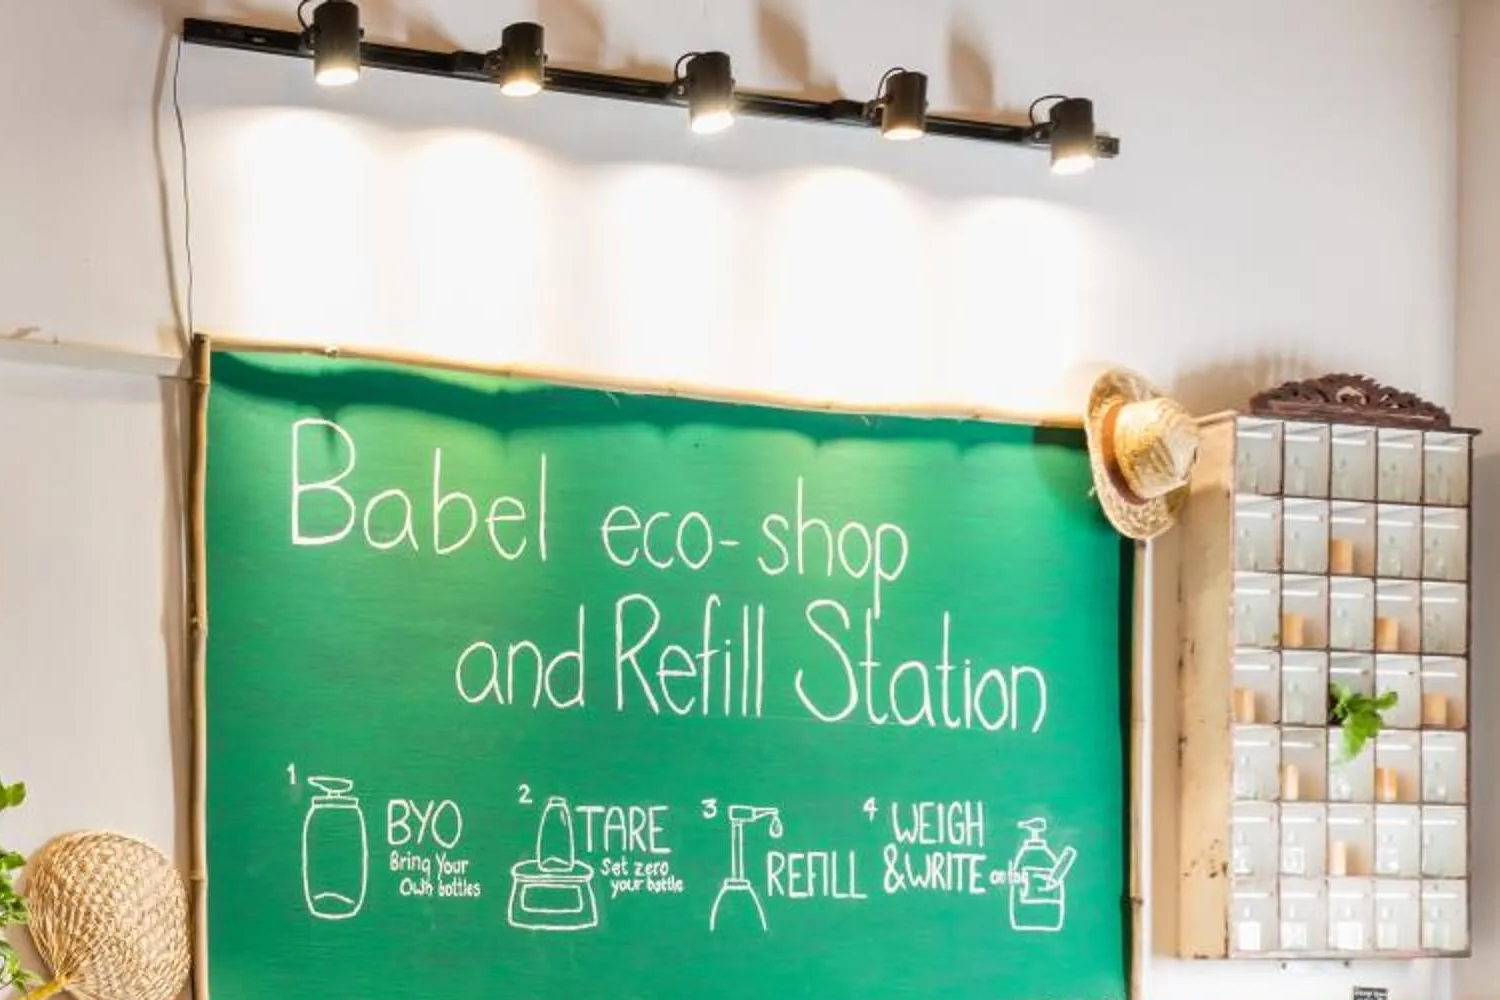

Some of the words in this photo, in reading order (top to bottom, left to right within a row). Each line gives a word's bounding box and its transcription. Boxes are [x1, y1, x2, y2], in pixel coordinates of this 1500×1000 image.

[292, 418, 547, 563] Babel
[455, 604, 584, 708] and
[615, 593, 764, 717] Refill
[795, 599, 1047, 733] Station
[286, 762, 297, 785] 1
[518, 783, 533, 804] 2
[701, 797, 717, 819] 3
[863, 796, 878, 822] 4
[387, 798, 463, 849] BYO
[575, 805, 672, 854] TARE
[892, 800, 984, 848] WEIGH
[389, 850, 431, 881] Bring
[435, 852, 469, 881] Your
[600, 856, 630, 877] Set
[633, 860, 669, 877] zero
[766, 850, 868, 899] REFILL
[399, 878, 433, 897] Own
[438, 878, 481, 897] bottles
[610, 877, 644, 900] your
[648, 874, 684, 893] bottle
